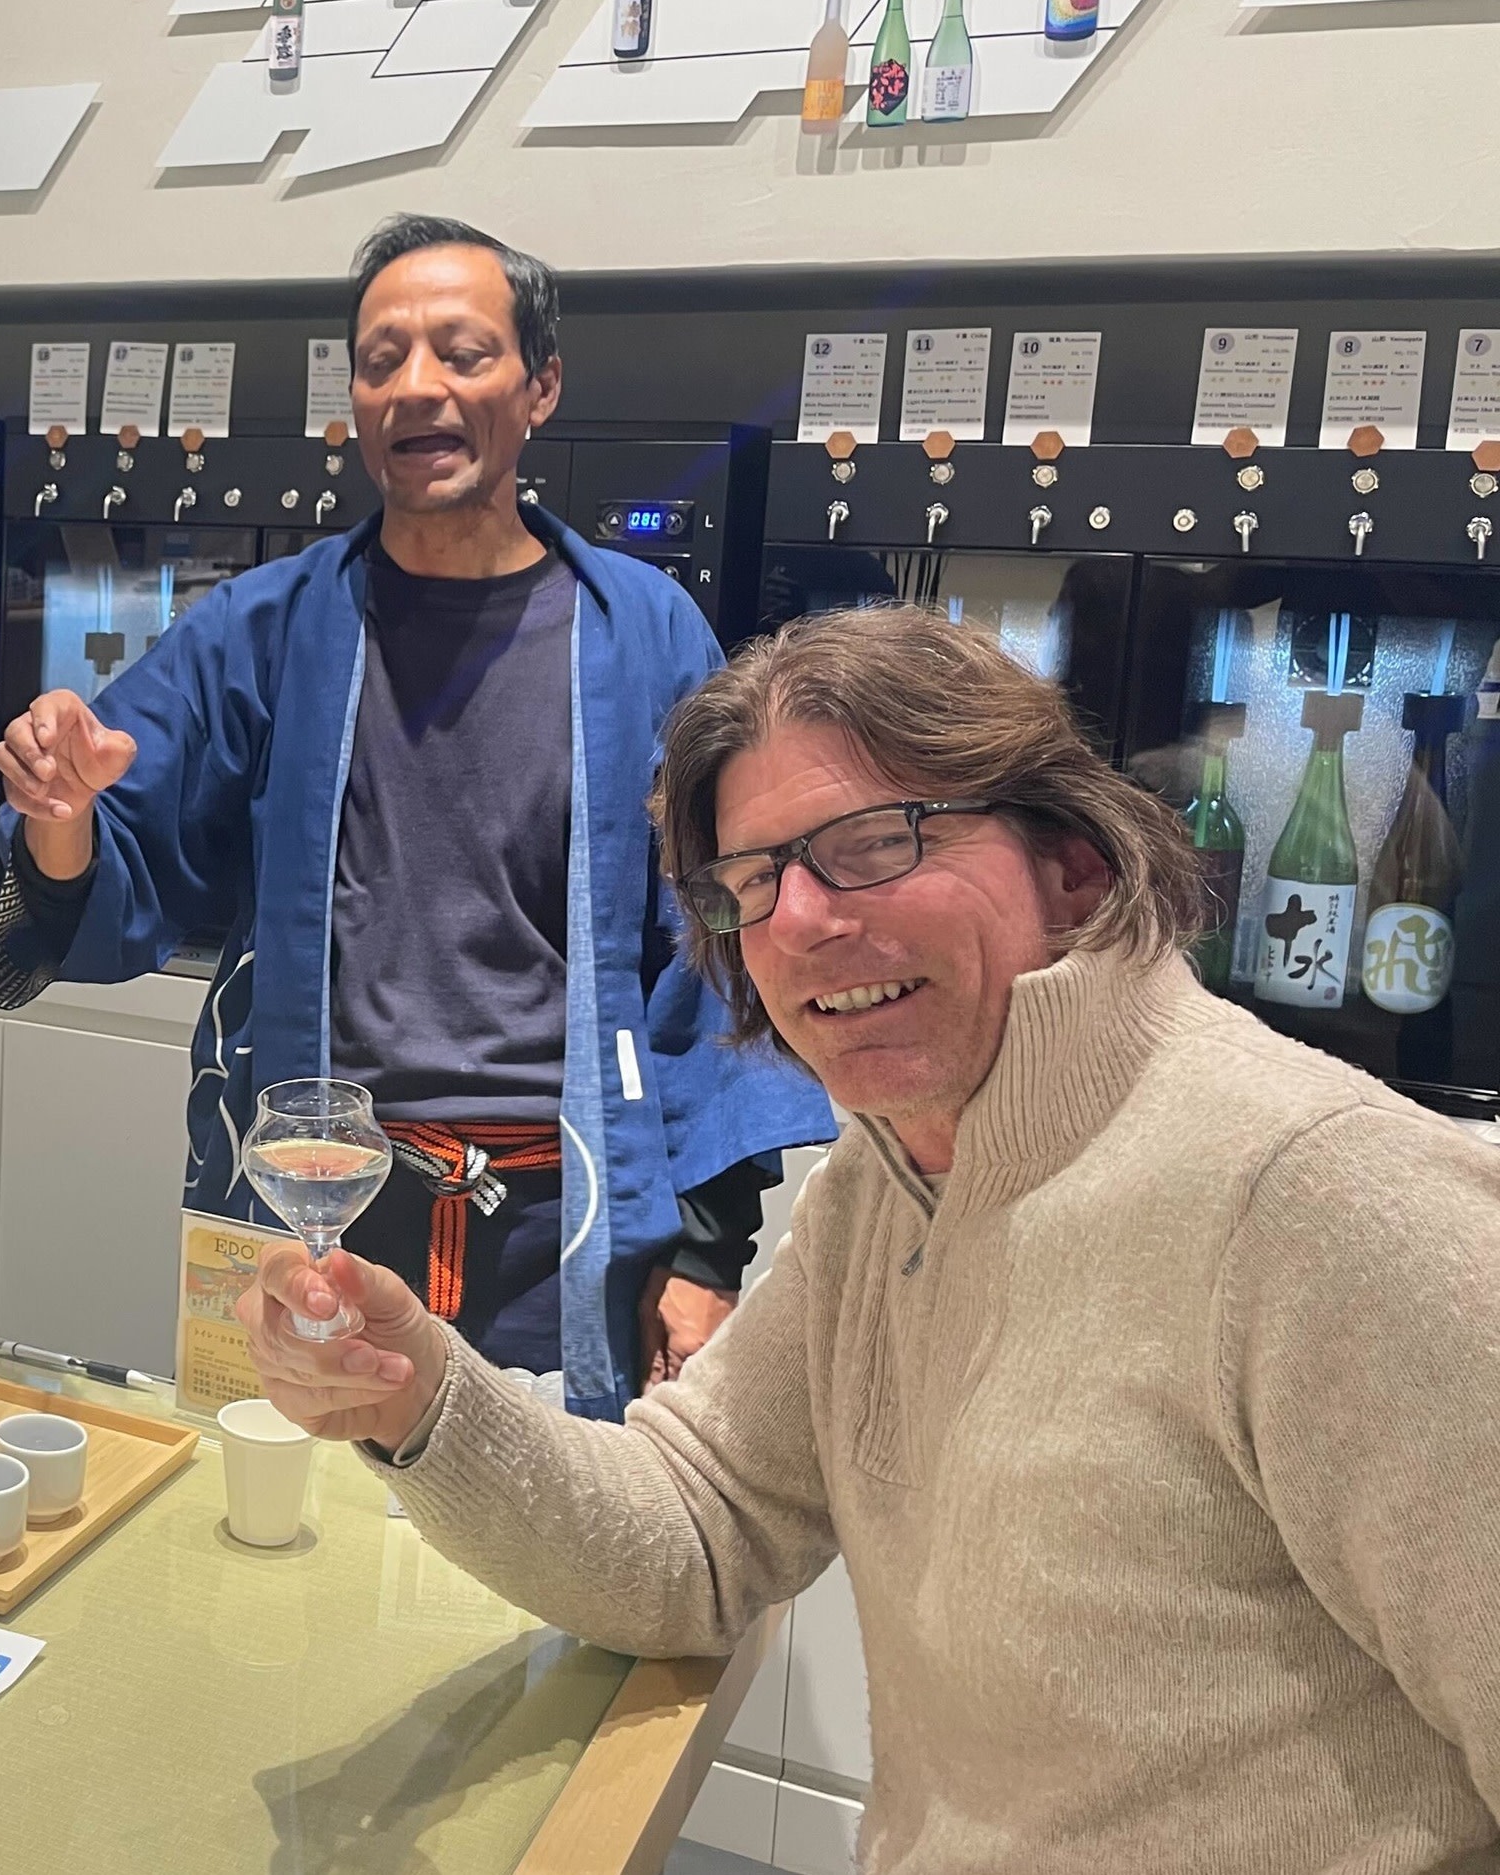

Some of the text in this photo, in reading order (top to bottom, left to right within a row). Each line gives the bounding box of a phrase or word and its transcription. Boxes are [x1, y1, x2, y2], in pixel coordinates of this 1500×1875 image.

[813, 342, 830, 355] 12
[916, 338, 931, 351] 11
[1023, 342, 1039, 354] 10
[1217, 338, 1227, 350] 9
[1344, 341, 1354, 353] 8
[1474, 339, 1484, 351] 7
[314, 346, 329, 358] 15
[704, 515, 714, 528] L
[700, 570, 711, 583] R
[214, 1237, 255, 1260] EDO
